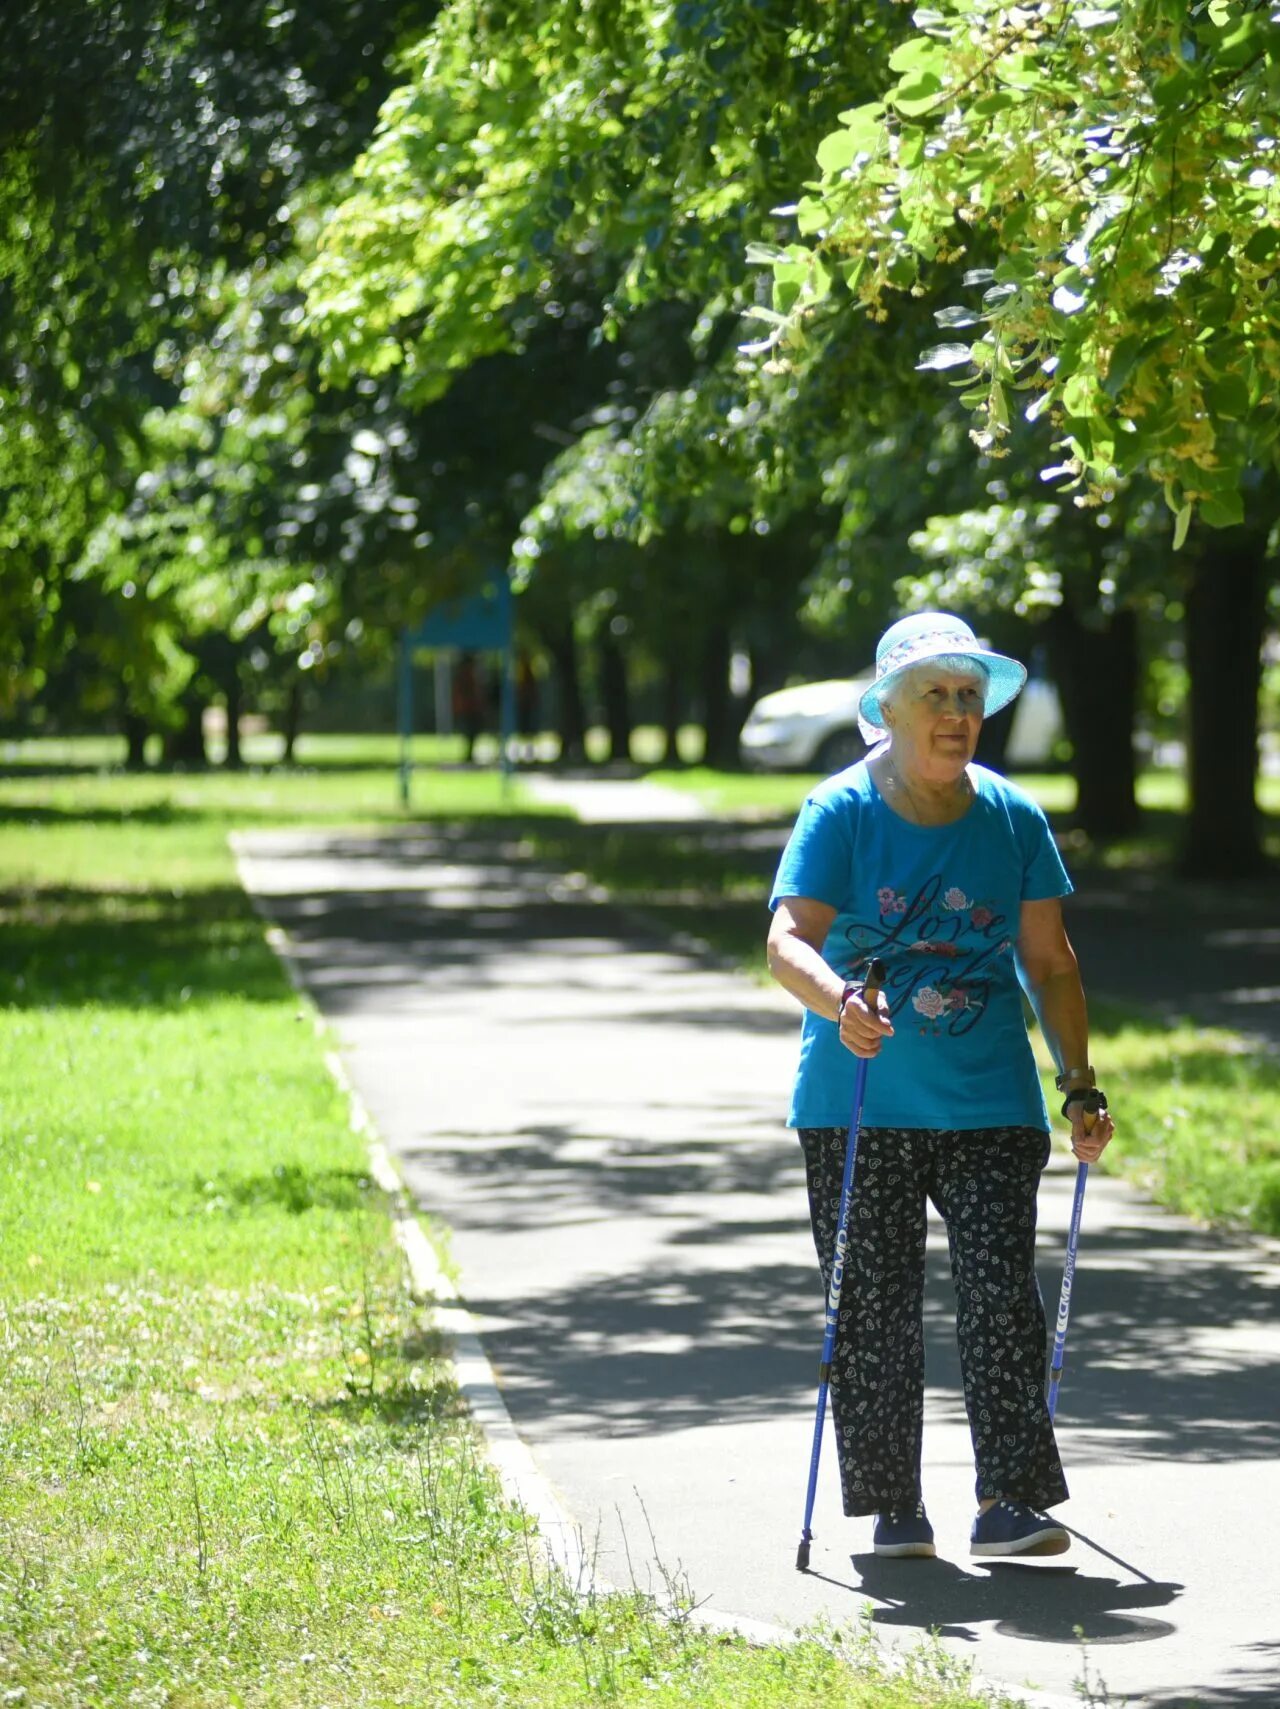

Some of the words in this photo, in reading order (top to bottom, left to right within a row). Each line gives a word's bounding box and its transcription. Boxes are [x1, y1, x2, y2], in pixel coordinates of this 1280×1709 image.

[845, 874, 1009, 957] Love
[833, 1229, 847, 1285] CMD
[1059, 1276, 1072, 1315] CMD
